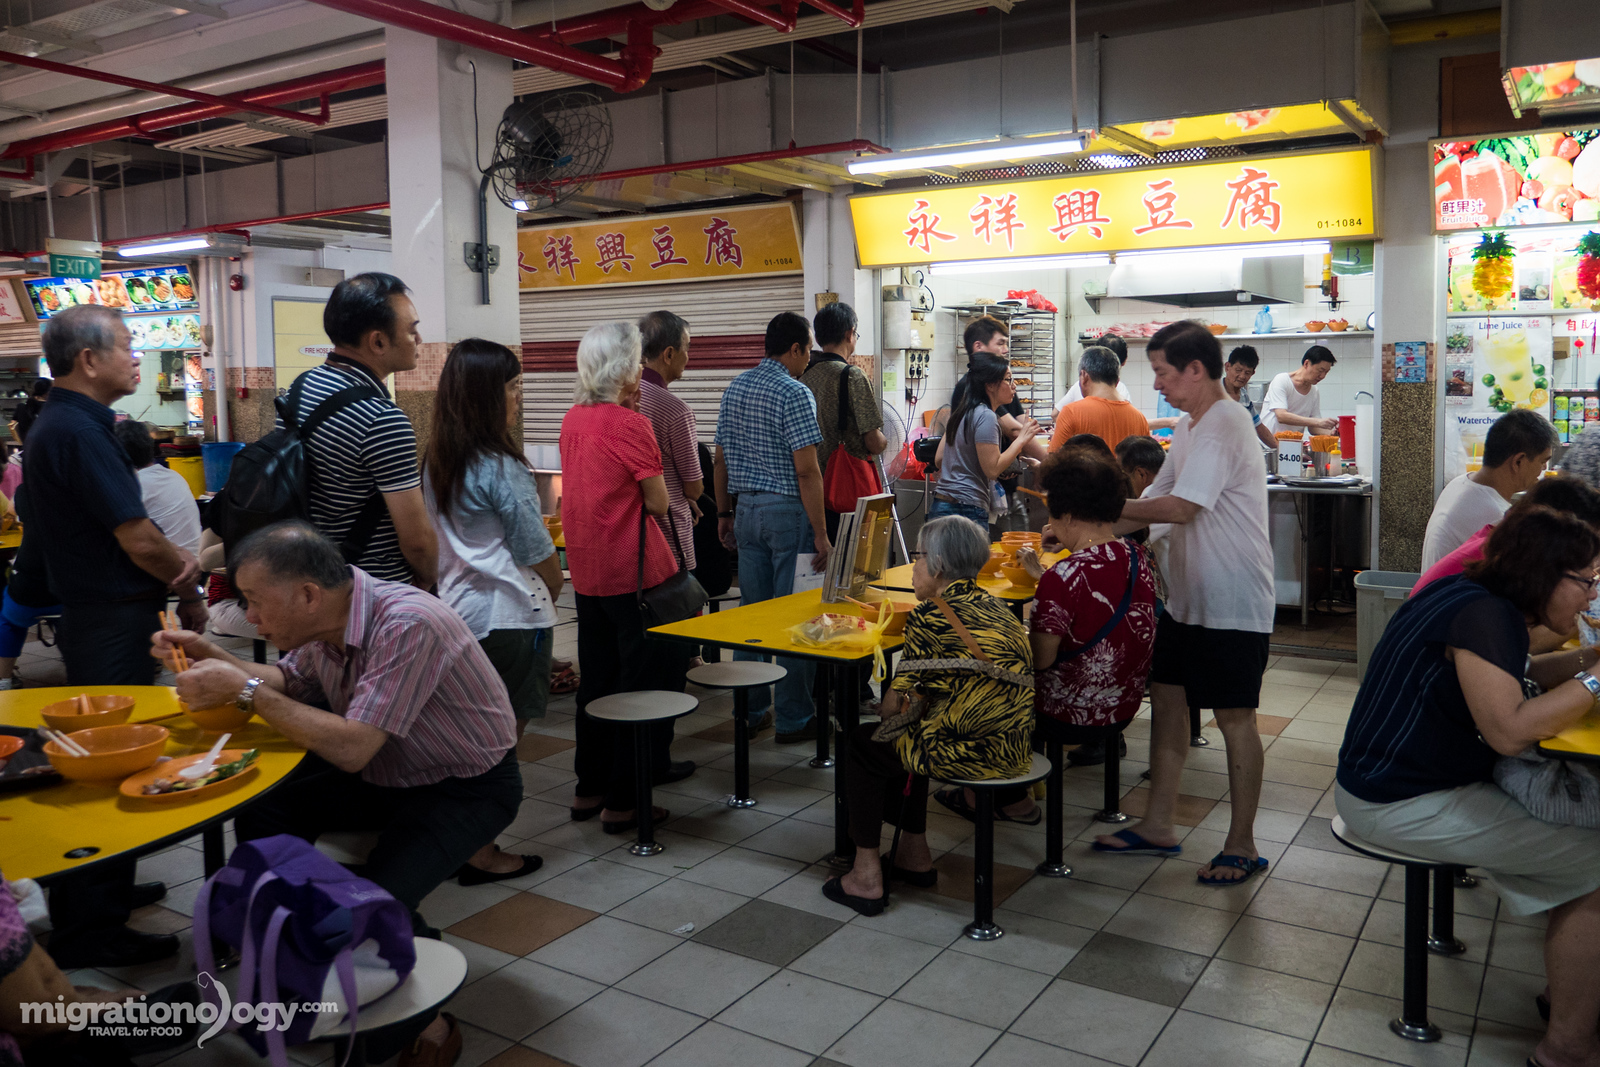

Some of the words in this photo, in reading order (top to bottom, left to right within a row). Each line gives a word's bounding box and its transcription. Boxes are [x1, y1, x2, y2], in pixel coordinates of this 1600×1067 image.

[902, 166, 1283, 254] 永祥興豆腐
[1317, 217, 1363, 229] 01-1084
[56, 258, 87, 275] EXIT
[764, 257, 793, 267] 01-1084
[1478, 322, 1499, 330] Lime
[1502, 321, 1523, 331] Juice
[1457, 416, 1498, 425] Waterche
[1278, 453, 1301, 463] $4.00
